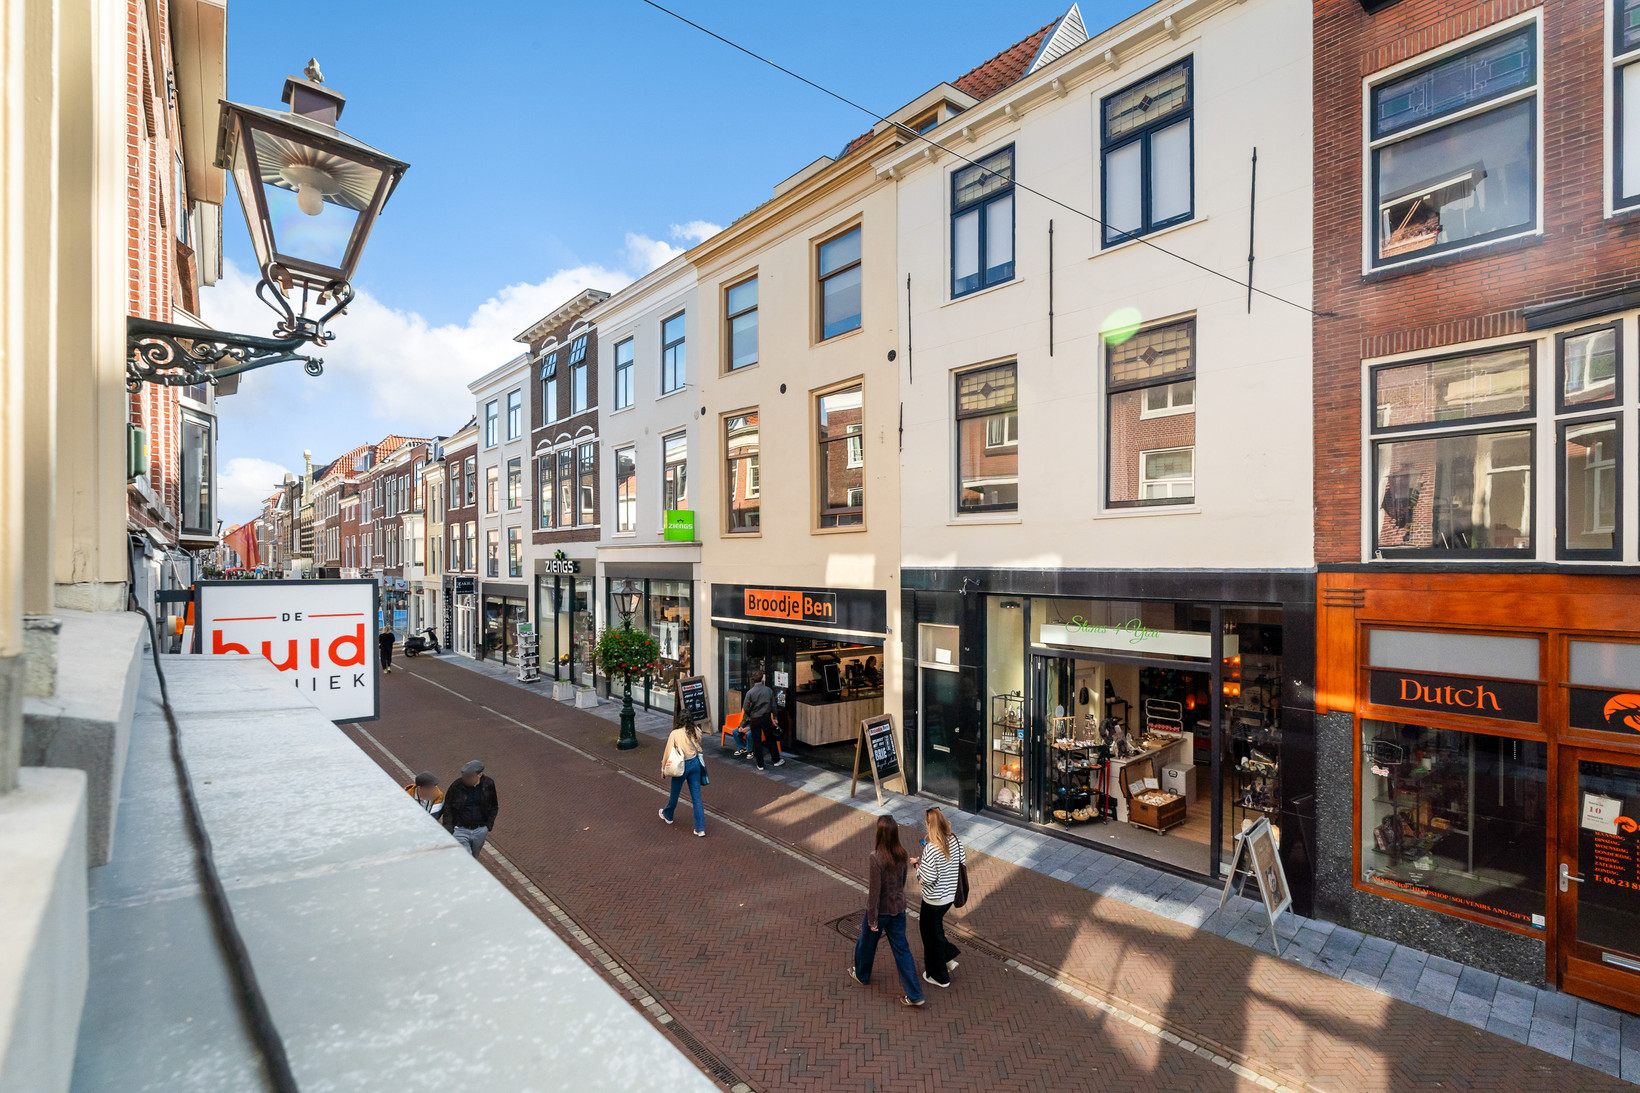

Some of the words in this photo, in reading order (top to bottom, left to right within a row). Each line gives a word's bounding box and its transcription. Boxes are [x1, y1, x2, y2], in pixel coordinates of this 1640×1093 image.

[545, 560, 574, 573] ZIENGS
[748, 594, 799, 617] Broodje
[804, 597, 832, 617] Ben
[282, 612, 303, 622] DE
[1065, 615, 1107, 633] Stones
[1125, 618, 1160, 644] You
[1399, 679, 1502, 711] Dutch
[1603, 876, 1616, 885] 06
[1617, 879, 1630, 888] 23
[1492, 907, 1509, 916] AND
[1509, 911, 1531, 921] GIFTS
